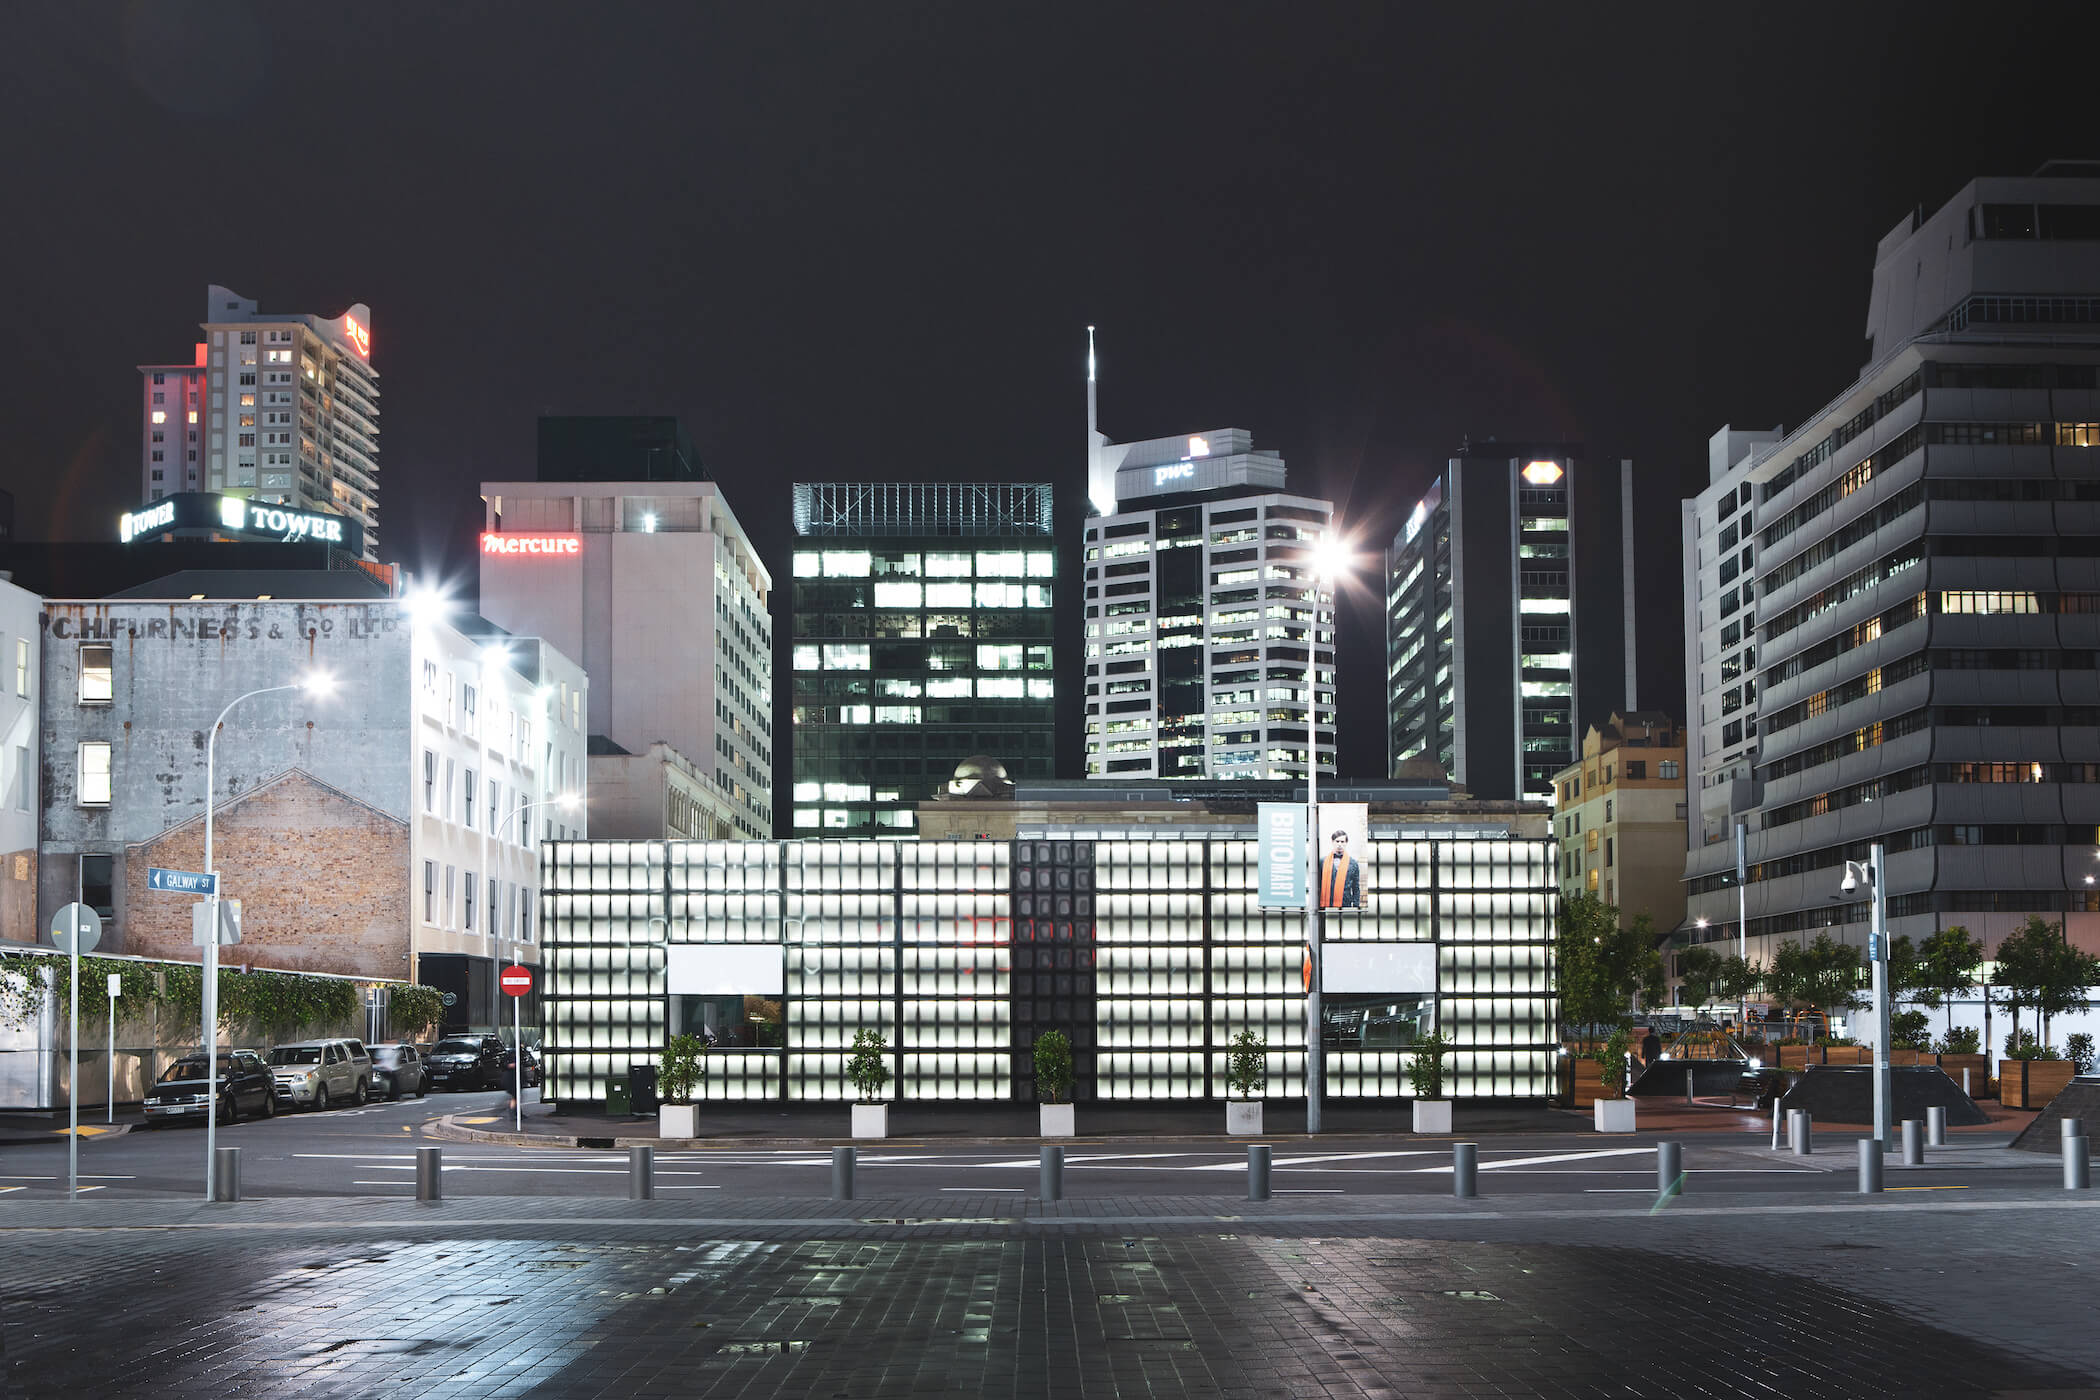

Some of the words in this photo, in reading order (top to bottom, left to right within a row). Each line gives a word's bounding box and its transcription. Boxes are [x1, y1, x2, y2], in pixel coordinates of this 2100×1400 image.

[1155, 463, 1194, 486] pwc
[132, 501, 175, 536] TOWER
[251, 507, 343, 542] TOWER
[483, 533, 579, 554] Mercure
[267, 623, 284, 640] &
[1270, 812, 1296, 898] BRITOMART
[166, 874, 199, 889] GALWAY
[201, 878, 211, 888] ST
